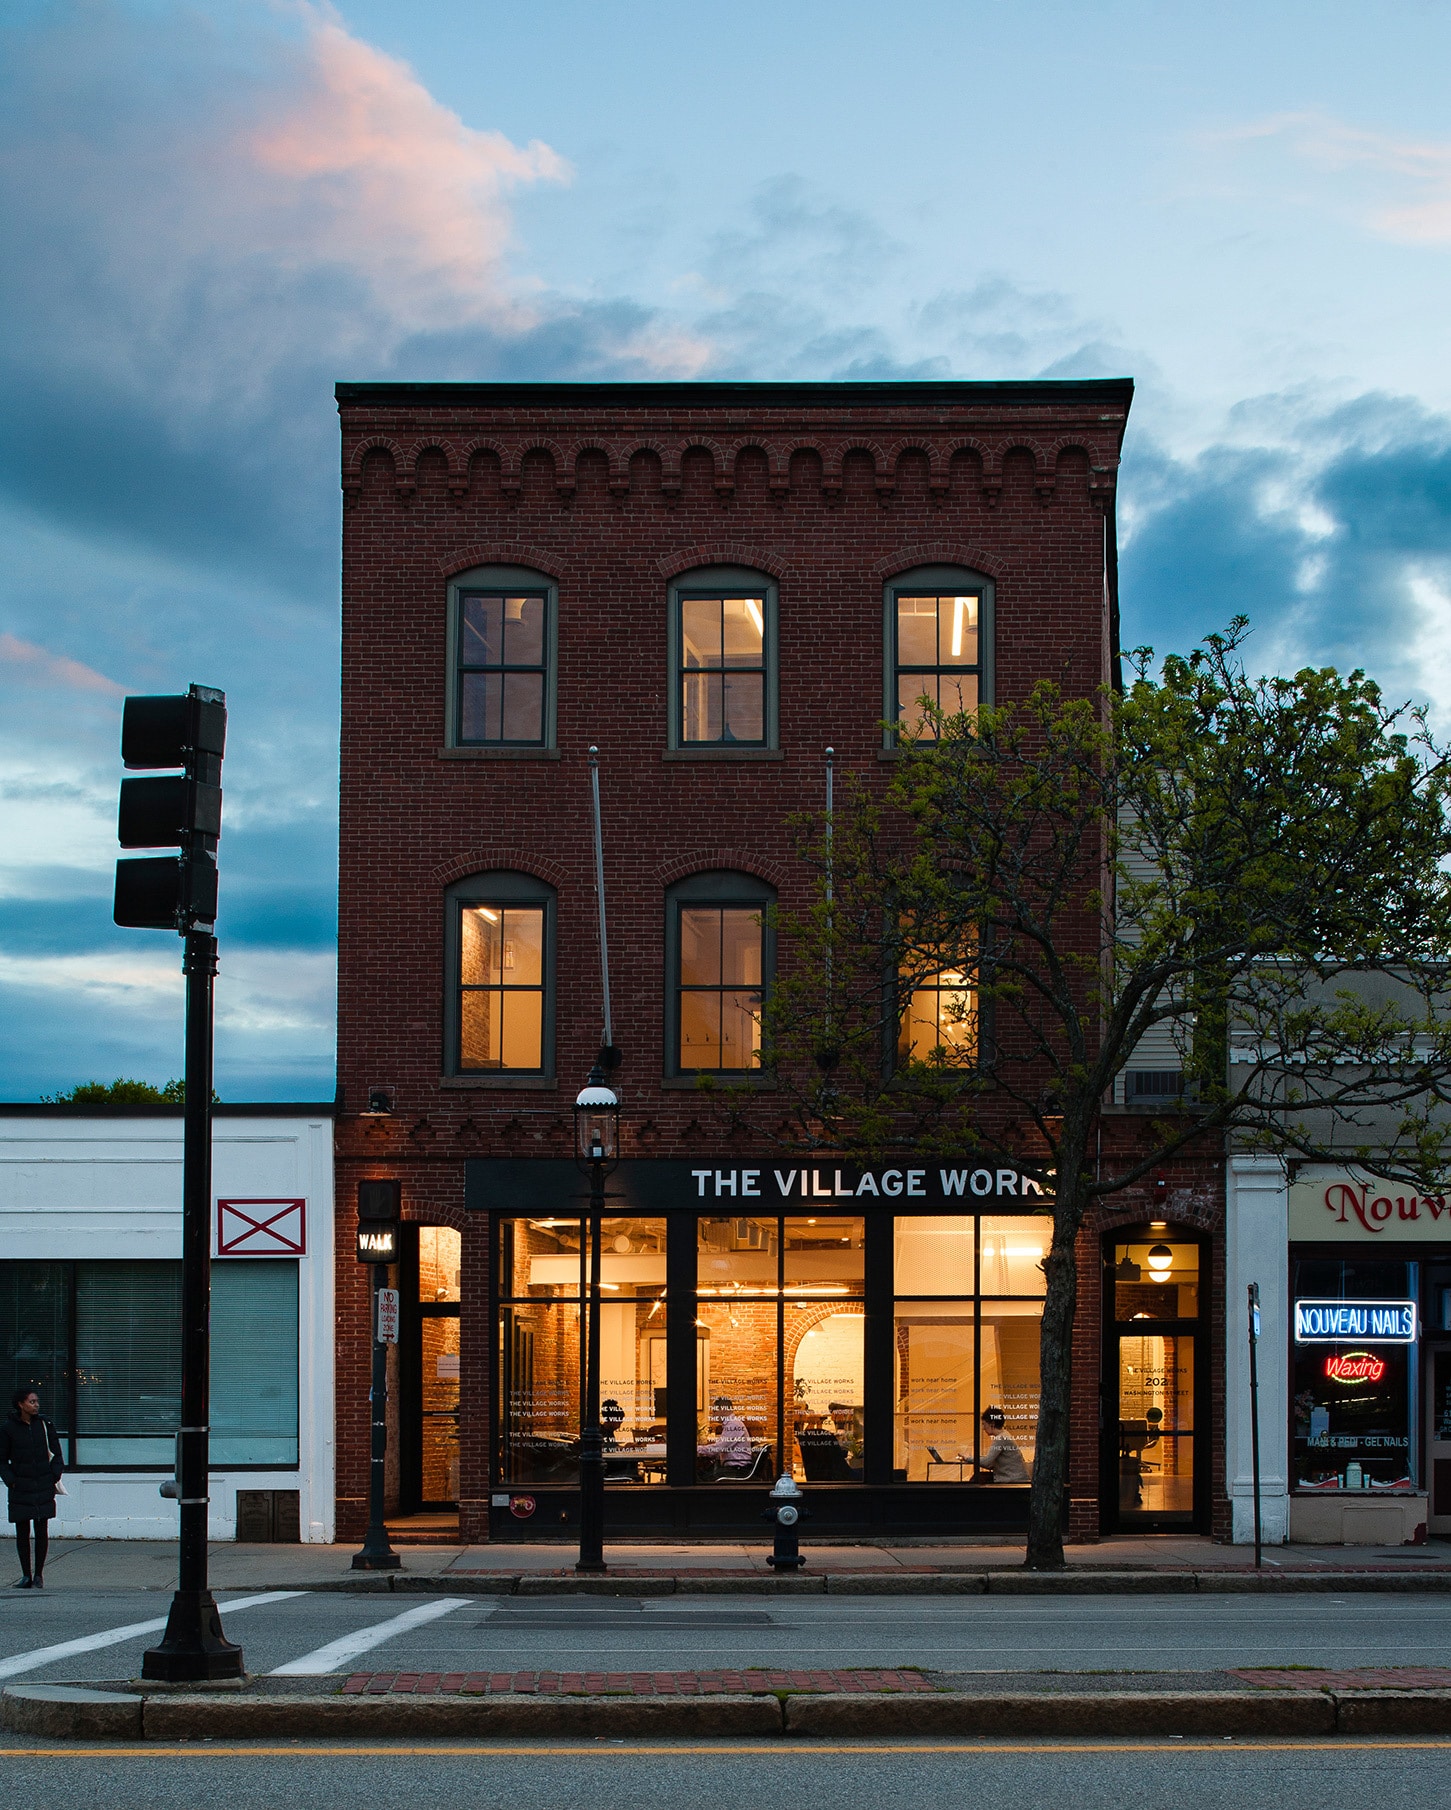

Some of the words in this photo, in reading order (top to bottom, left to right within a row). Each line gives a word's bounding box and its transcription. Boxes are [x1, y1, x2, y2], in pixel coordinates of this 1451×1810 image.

[691, 1170, 761, 1196] THE
[774, 1170, 926, 1196] VILLAGE
[1325, 1184, 1451, 1233] Nouv
[359, 1233, 393, 1250] WALK
[384, 1292, 395, 1303] NO
[380, 1303, 398, 1314] PARKING
[1299, 1308, 1367, 1334] NOUVEAU
[1372, 1307, 1412, 1335] NAILS
[1327, 1358, 1384, 1380] Waxing
[1145, 1377, 1169, 1387] 202
[1307, 1437, 1329, 1448] MANI
[1338, 1437, 1358, 1448] PEDI
[1365, 1437, 1382, 1448] GEL
[1383, 1437, 1410, 1448] NAILS
